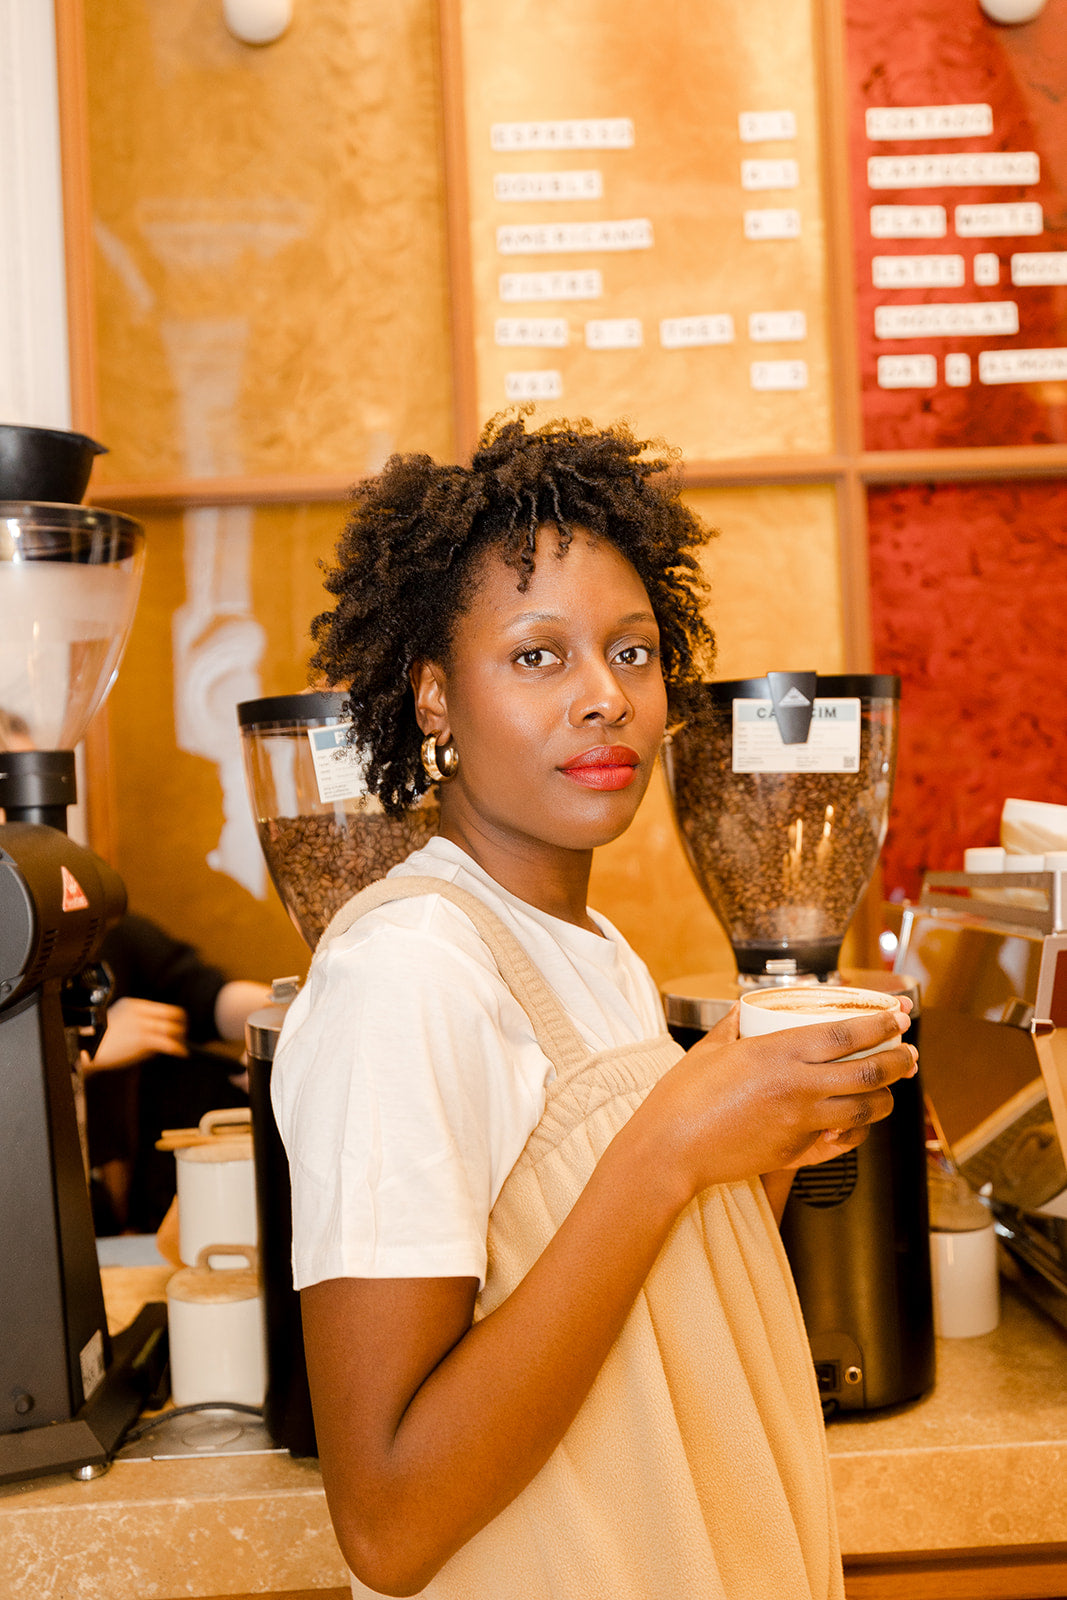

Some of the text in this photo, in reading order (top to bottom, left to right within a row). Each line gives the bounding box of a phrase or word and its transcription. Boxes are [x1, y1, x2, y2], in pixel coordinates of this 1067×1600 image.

[495, 124, 630, 146] ESPRESSO
[873, 160, 1034, 179] CAPPUCCINO
[498, 176, 598, 196] DOUBLE
[501, 225, 649, 247] AMERICANO
[503, 275, 599, 296] FILTRE
